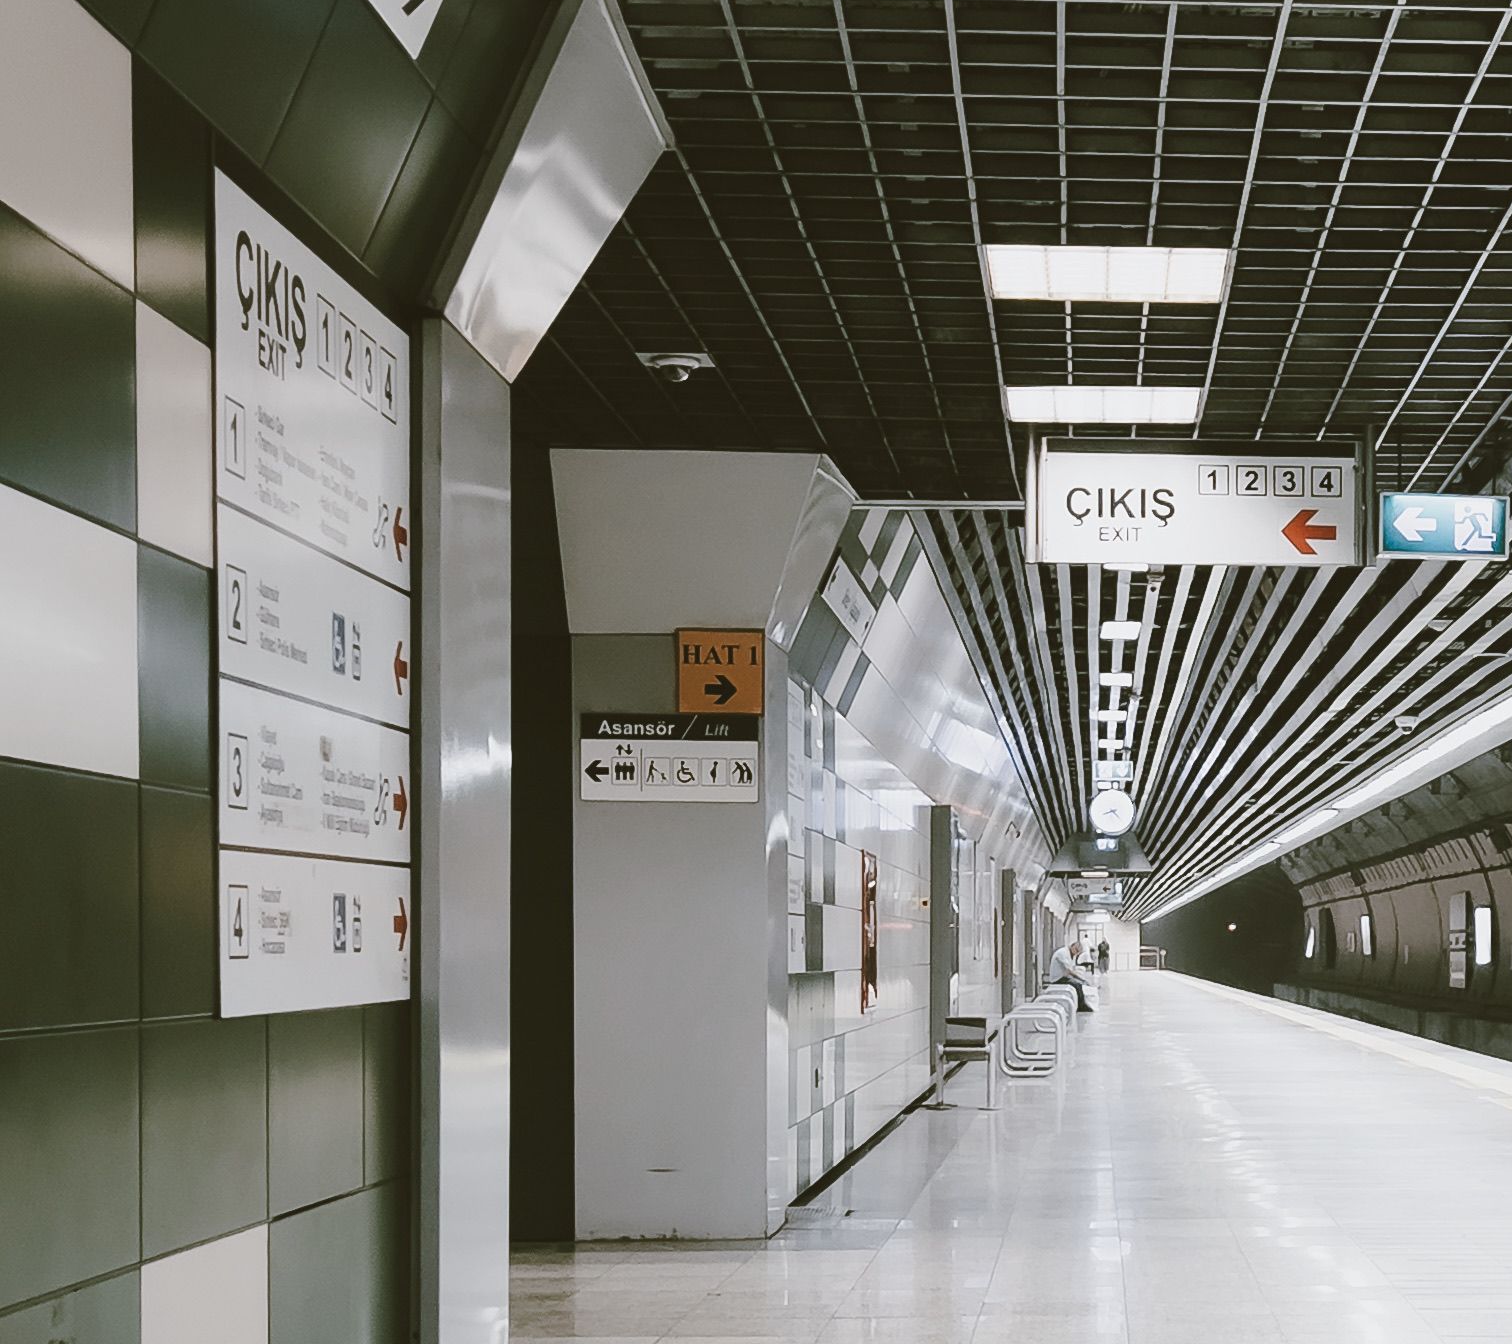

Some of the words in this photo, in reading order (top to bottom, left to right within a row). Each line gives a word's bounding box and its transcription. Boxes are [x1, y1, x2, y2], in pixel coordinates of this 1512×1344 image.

[235, 230, 307, 369] ÇIKIŞ
[258, 327, 287, 381] EXIT
[321, 311, 329, 363] 1
[344, 329, 353, 380] 2
[364, 346, 373, 394] 3
[384, 364, 393, 410] 4
[230, 413, 237, 464] 1
[1207, 470, 1217, 491] 1
[1244, 470, 1259, 492] 2
[1281, 470, 1297, 492] 3
[1318, 471, 1335, 492] 4
[1066, 487, 1175, 528] ÇIKIŞ
[1098, 527, 1139, 542] EXIT
[232, 579, 241, 631] 2
[682, 644, 740, 665] HAT
[750, 645, 758, 666] 1
[598, 719, 675, 736] Asansör
[705, 723, 729, 737] Lift
[233, 747, 242, 798] 3
[233, 897, 243, 947] 4
